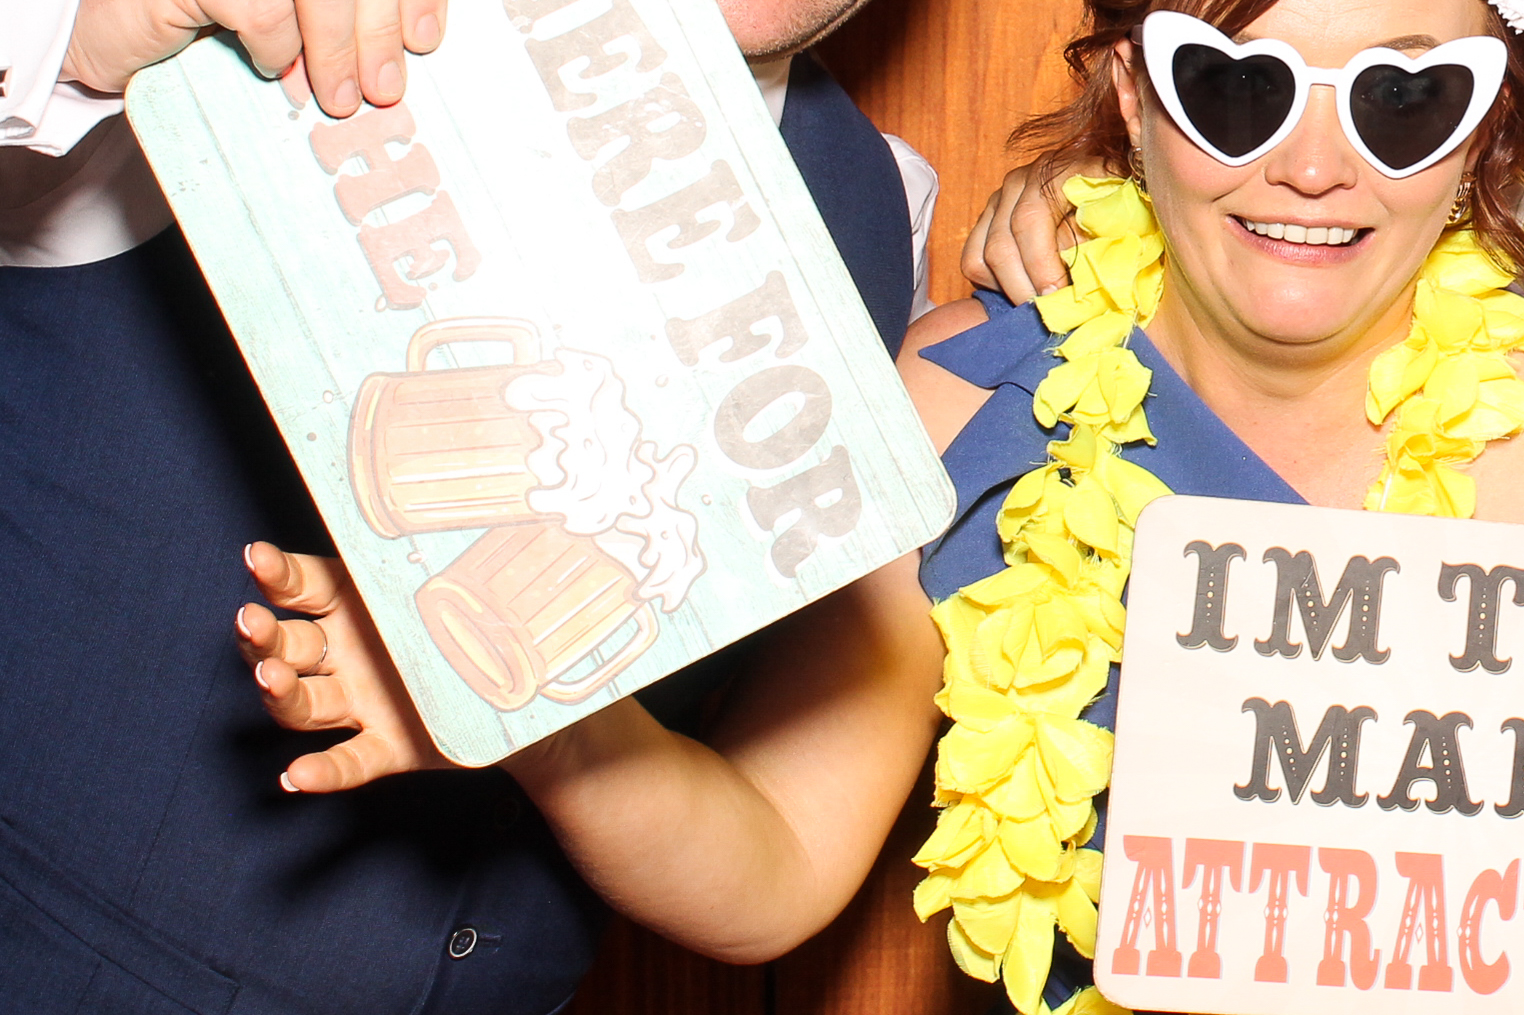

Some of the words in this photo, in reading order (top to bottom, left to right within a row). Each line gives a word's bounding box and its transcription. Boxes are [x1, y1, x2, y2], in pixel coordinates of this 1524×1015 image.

[279, 54, 482, 311] HE
[665, 270, 862, 578] FOR
[1175, 540, 1400, 664] IM
